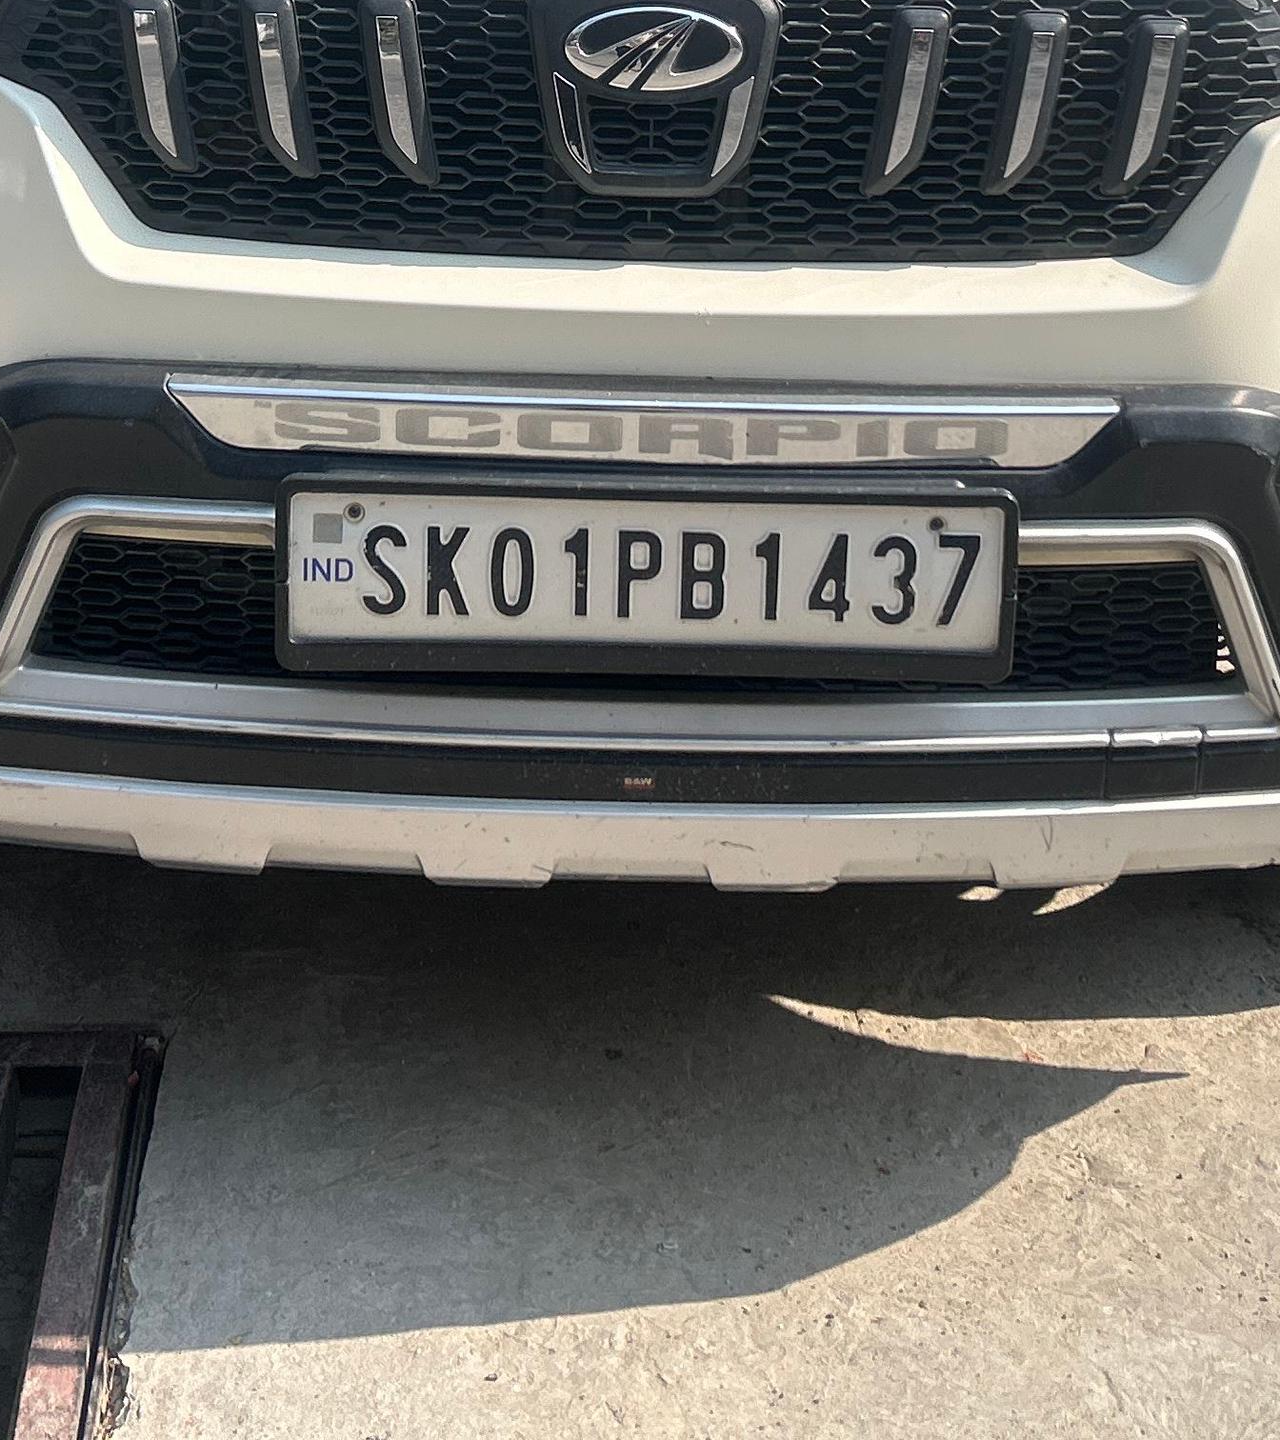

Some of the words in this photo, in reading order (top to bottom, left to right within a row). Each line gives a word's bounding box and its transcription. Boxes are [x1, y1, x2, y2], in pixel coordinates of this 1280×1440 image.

[273, 401, 1010, 461] SCORPIO
[303, 557, 354, 582] IND
[362, 523, 982, 626] SK01PB1437
